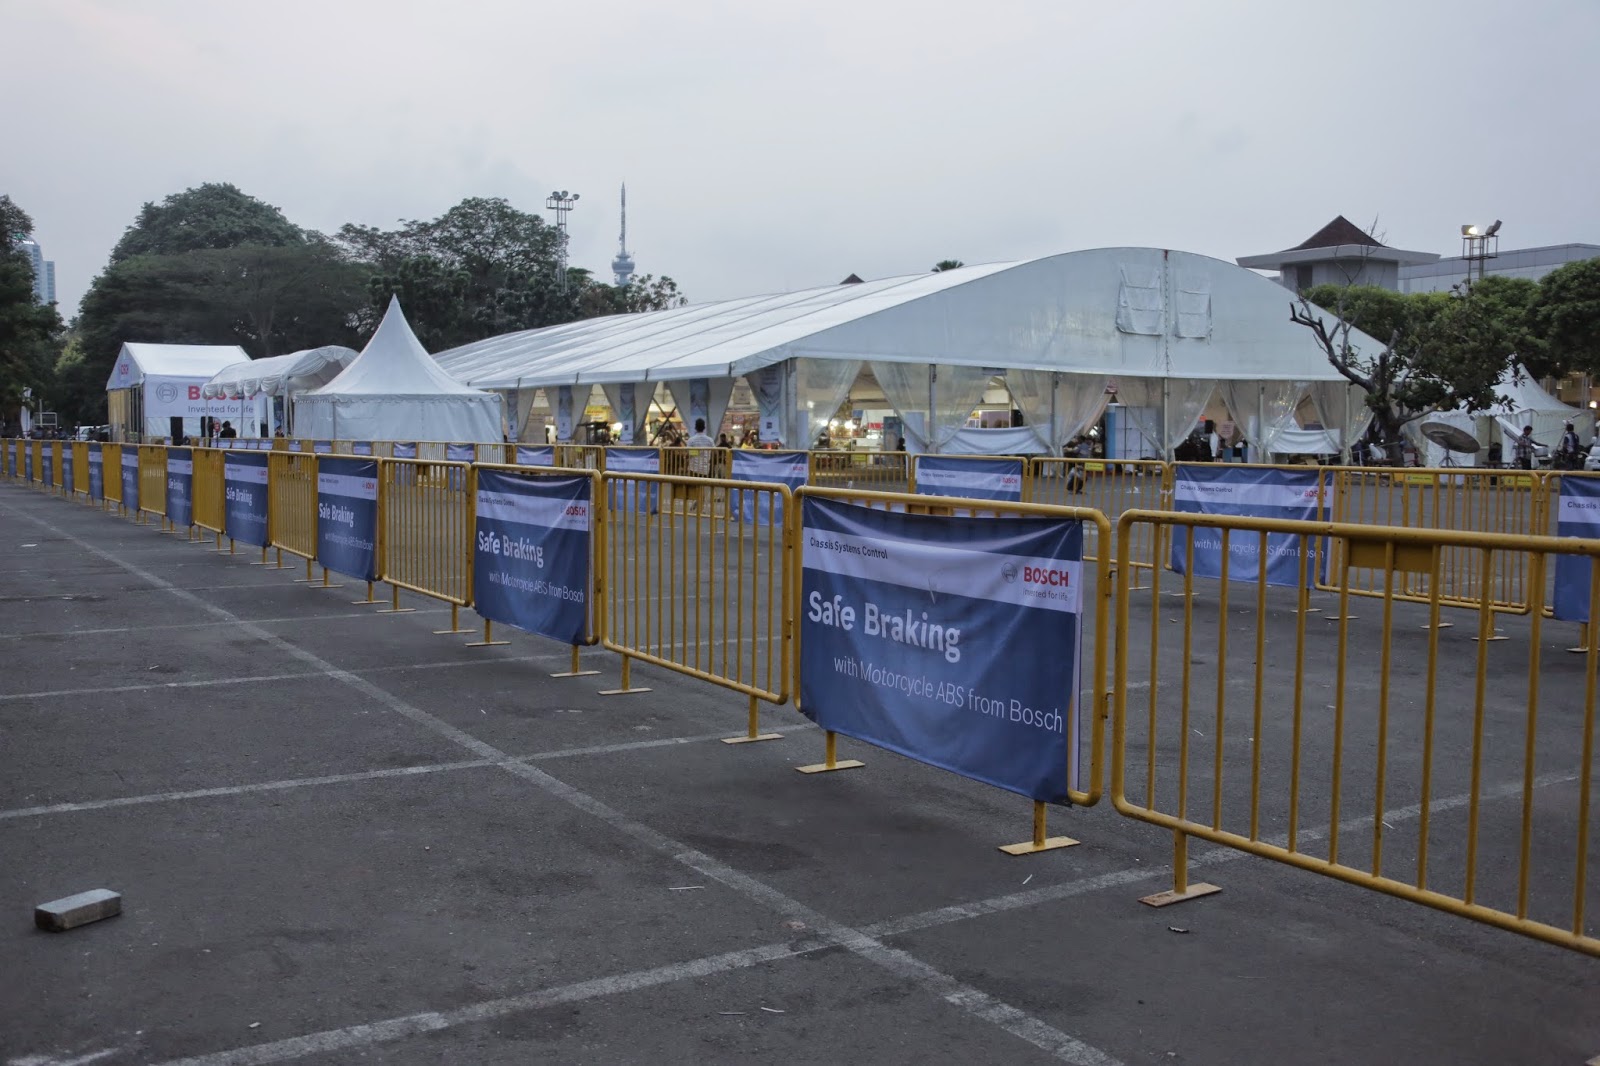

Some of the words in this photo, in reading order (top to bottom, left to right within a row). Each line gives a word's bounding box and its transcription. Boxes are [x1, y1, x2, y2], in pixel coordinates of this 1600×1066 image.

[227, 405, 239, 413] for
[565, 506, 586, 517] BOSCH
[1567, 501, 1597, 510] Chassis
[478, 531, 500, 554] Safe
[502, 535, 544, 568] Braking
[810, 537, 834, 550] Chassis
[834, 541, 861, 554] Systems
[862, 545, 888, 559] Control
[1194, 539, 1212, 549] with
[1024, 566, 1069, 587] BOSCH
[533, 580, 548, 595] ABS
[562, 586, 584, 603] Bosch
[808, 590, 856, 631] Safe
[864, 602, 961, 663] Braking
[834, 656, 858, 678] with
[860, 661, 933, 698] Motorcycle
[936, 681, 964, 707] ABS
[968, 688, 1004, 719] from
[1009, 698, 1063, 733] Bosch
